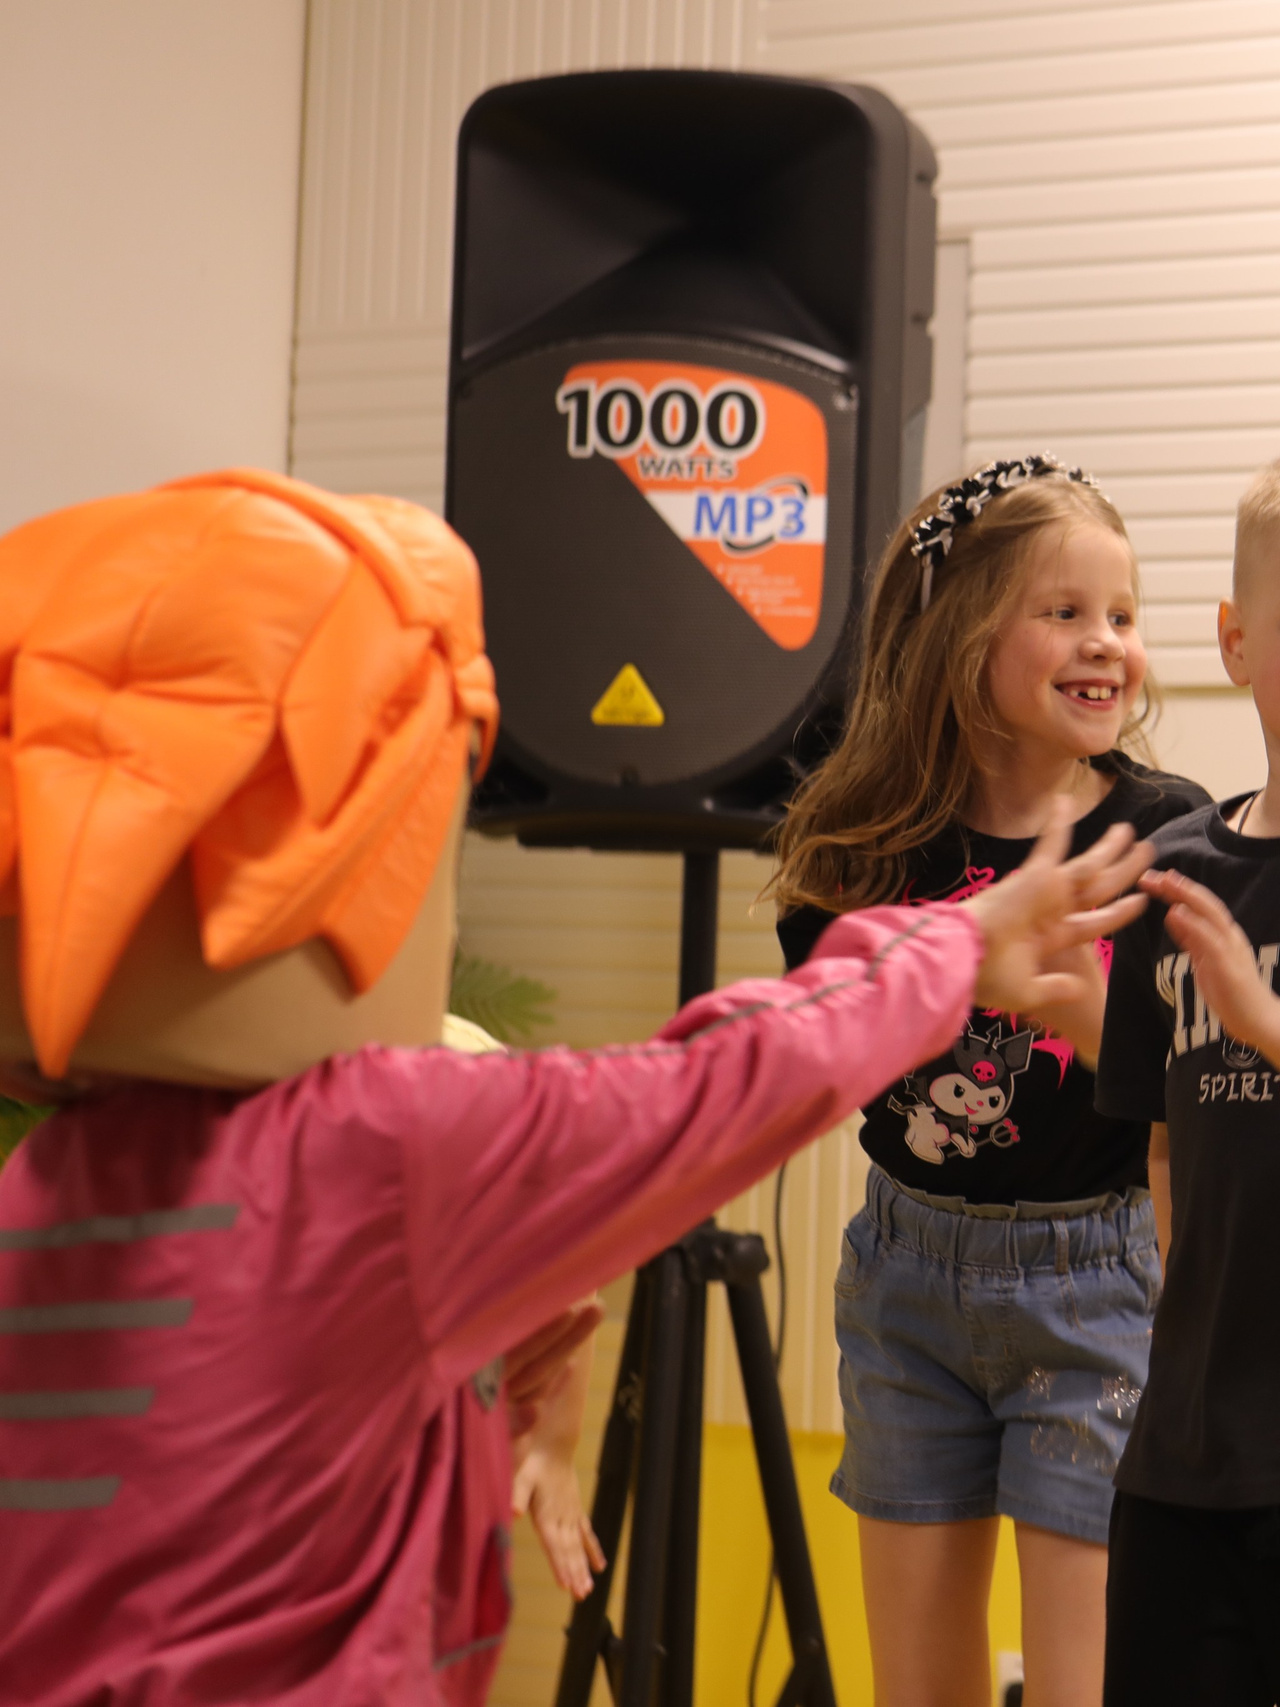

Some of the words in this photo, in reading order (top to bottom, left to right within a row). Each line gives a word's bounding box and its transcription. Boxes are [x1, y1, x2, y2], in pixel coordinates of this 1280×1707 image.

[558, 383, 762, 455] 1000
[638, 456, 735, 479] WATTS
[694, 494, 805, 539] MP3
